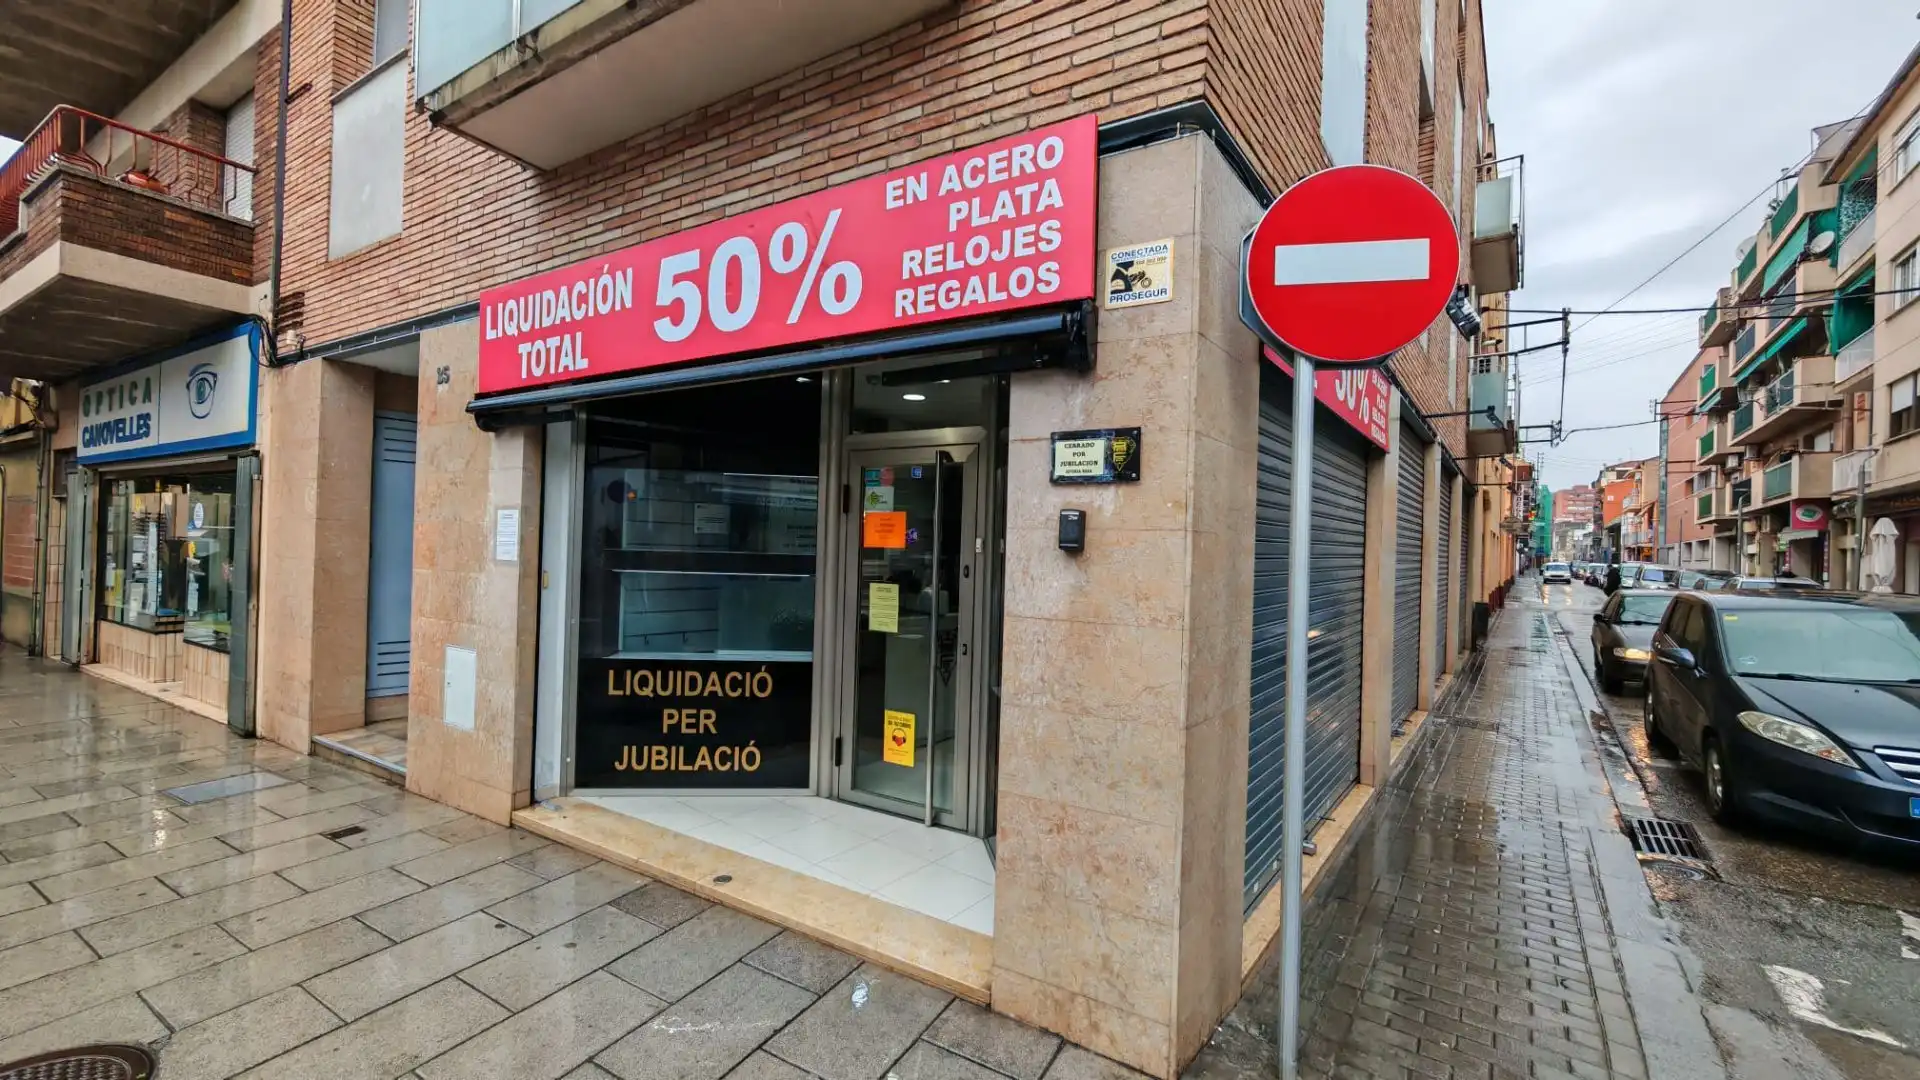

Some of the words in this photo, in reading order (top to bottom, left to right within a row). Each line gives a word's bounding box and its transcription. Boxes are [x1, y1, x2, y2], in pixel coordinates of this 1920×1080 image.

[886, 171, 928, 210] EN
[938, 136, 1065, 197] ACERO
[948, 177, 1064, 232] PLATA
[902, 219, 1062, 280] RELOJES
[1111, 244, 1168, 260] CONECTADA
[653, 207, 863, 343] 50%
[894, 261, 1061, 318] REGALOS
[1109, 288, 1168, 304] PROSEGUR
[486, 263, 633, 341] LIQUIDACIÓN
[518, 331, 589, 379] TOTAL
[82, 412, 151, 448] CANOVELLES
[608, 665, 773, 698] LIQUIDACIÓ
[662, 708, 718, 734] PER
[614, 740, 761, 772] JUBILACIÓ
